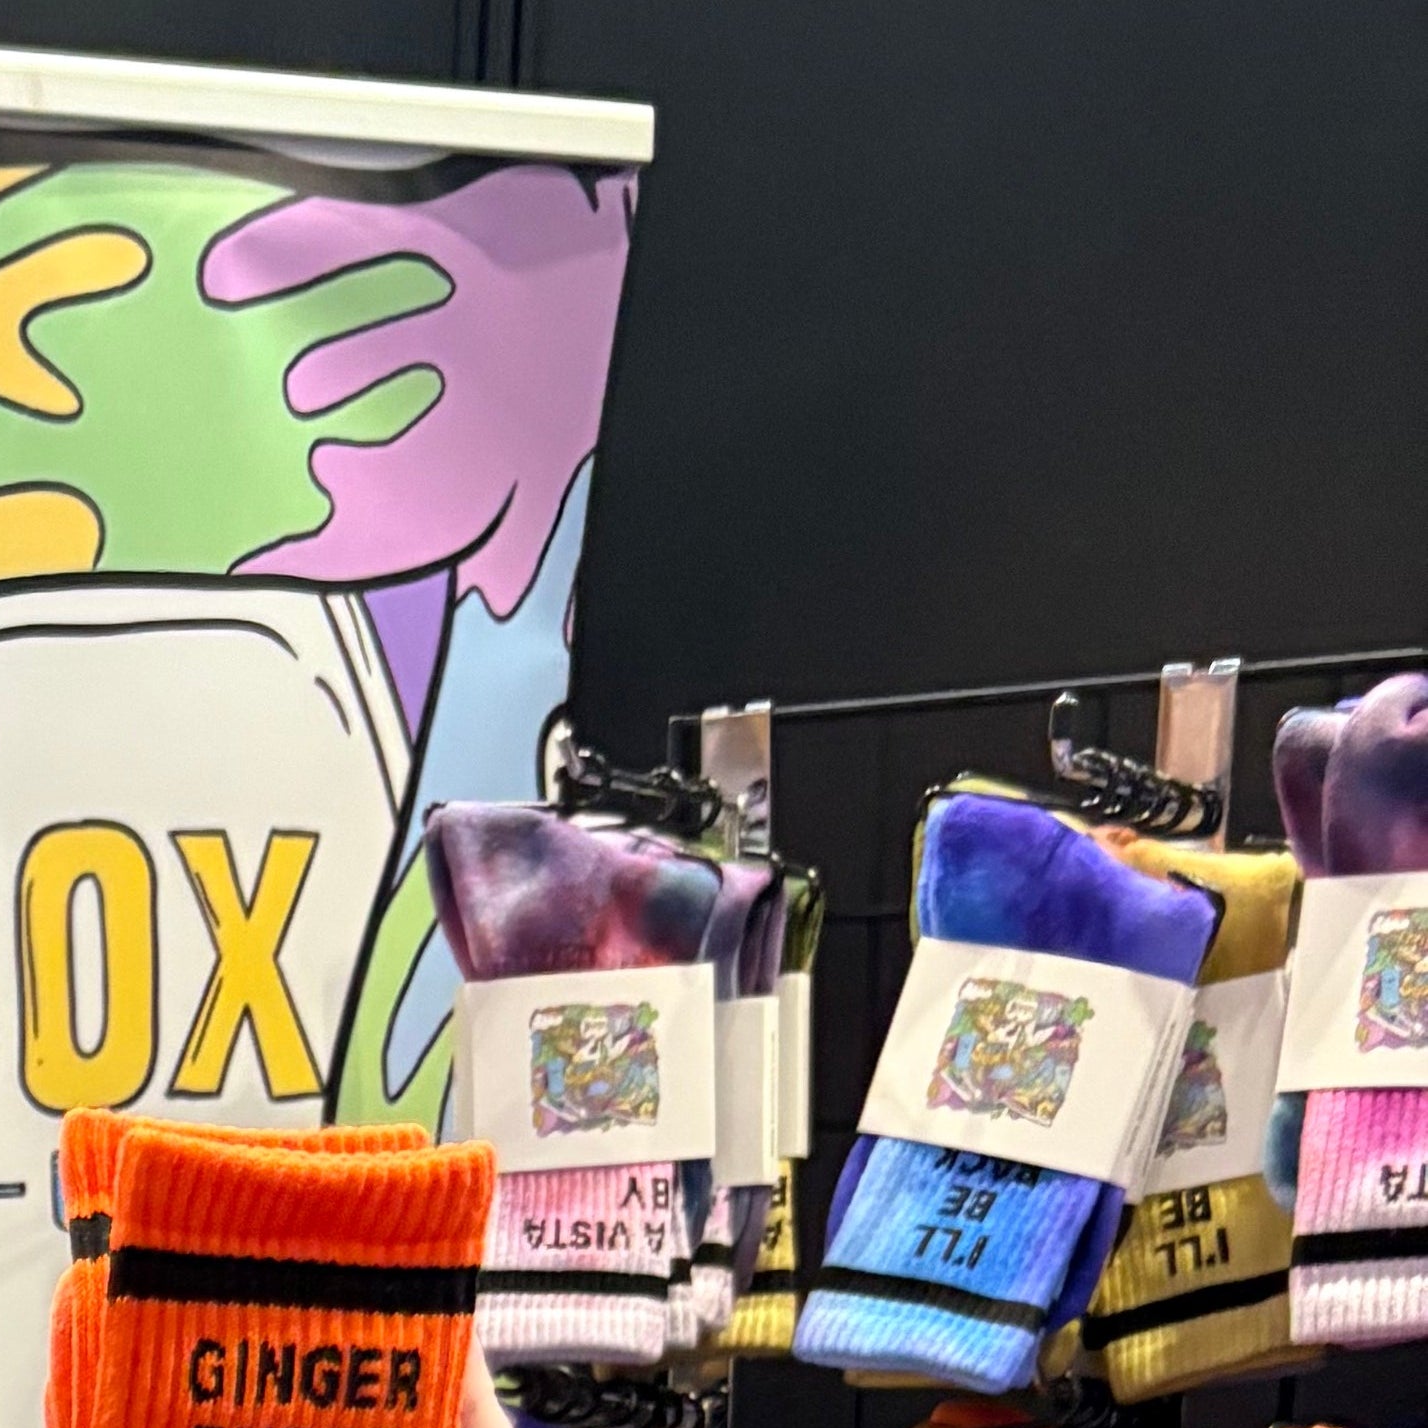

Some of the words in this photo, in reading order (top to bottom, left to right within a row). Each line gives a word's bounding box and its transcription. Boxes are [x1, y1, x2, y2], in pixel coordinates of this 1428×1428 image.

[619, 1175, 670, 1212] BY
[936, 1185, 998, 1226] BE
[1157, 1185, 1212, 1232] BE
[523, 1216, 632, 1252] VISTA
[643, 1218, 666, 1254] A
[911, 1225, 989, 1272] I'LL
[1155, 1227, 1230, 1278] I'LL
[187, 1338, 424, 1413] GINGER
